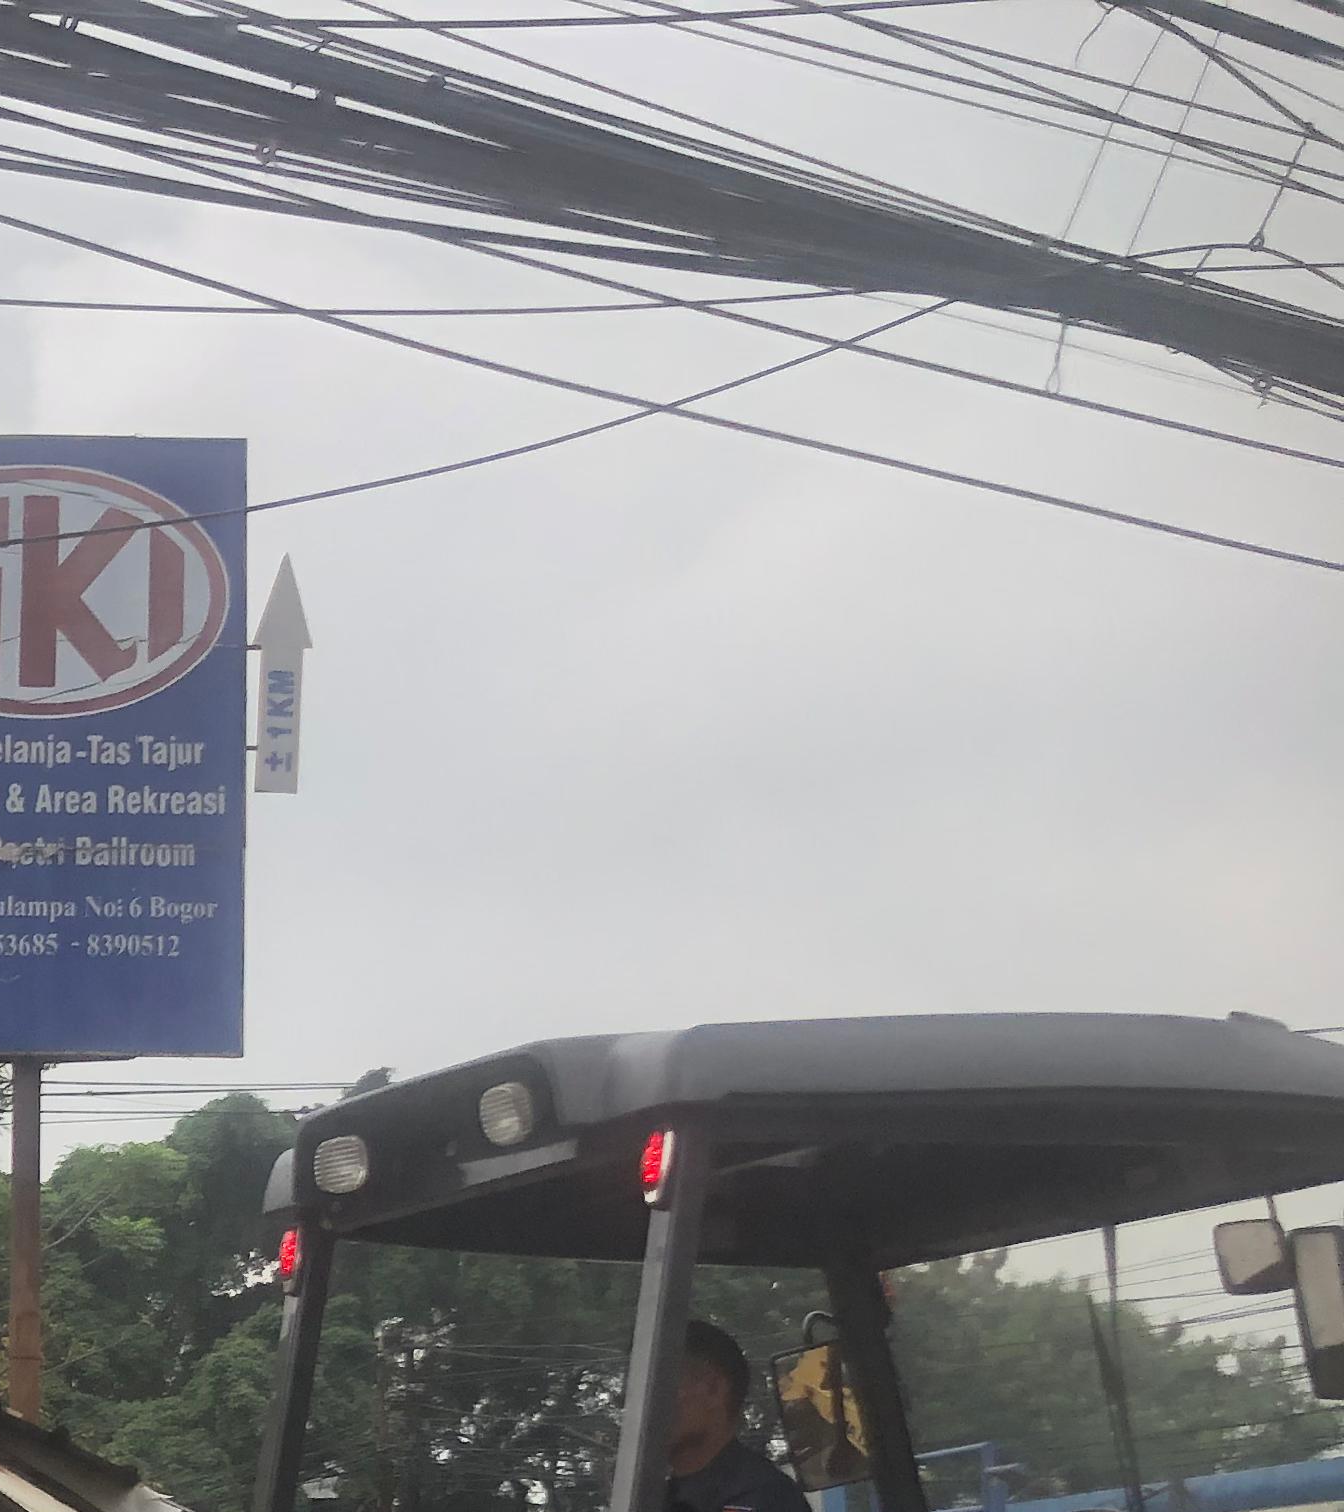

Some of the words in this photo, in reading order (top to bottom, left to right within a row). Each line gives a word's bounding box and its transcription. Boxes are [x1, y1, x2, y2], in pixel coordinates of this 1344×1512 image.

[136, 735, 204, 771] Tajur
[6, 783, 25, 813] &
[35, 784, 97, 814] Area
[107, 785, 227, 815] Rekreasi
[75, 836, 195, 867] Ballroom
[128, 896, 143, 918] 6
[150, 896, 218, 924] Bogor
[87, 934, 181, 957] 8390512
